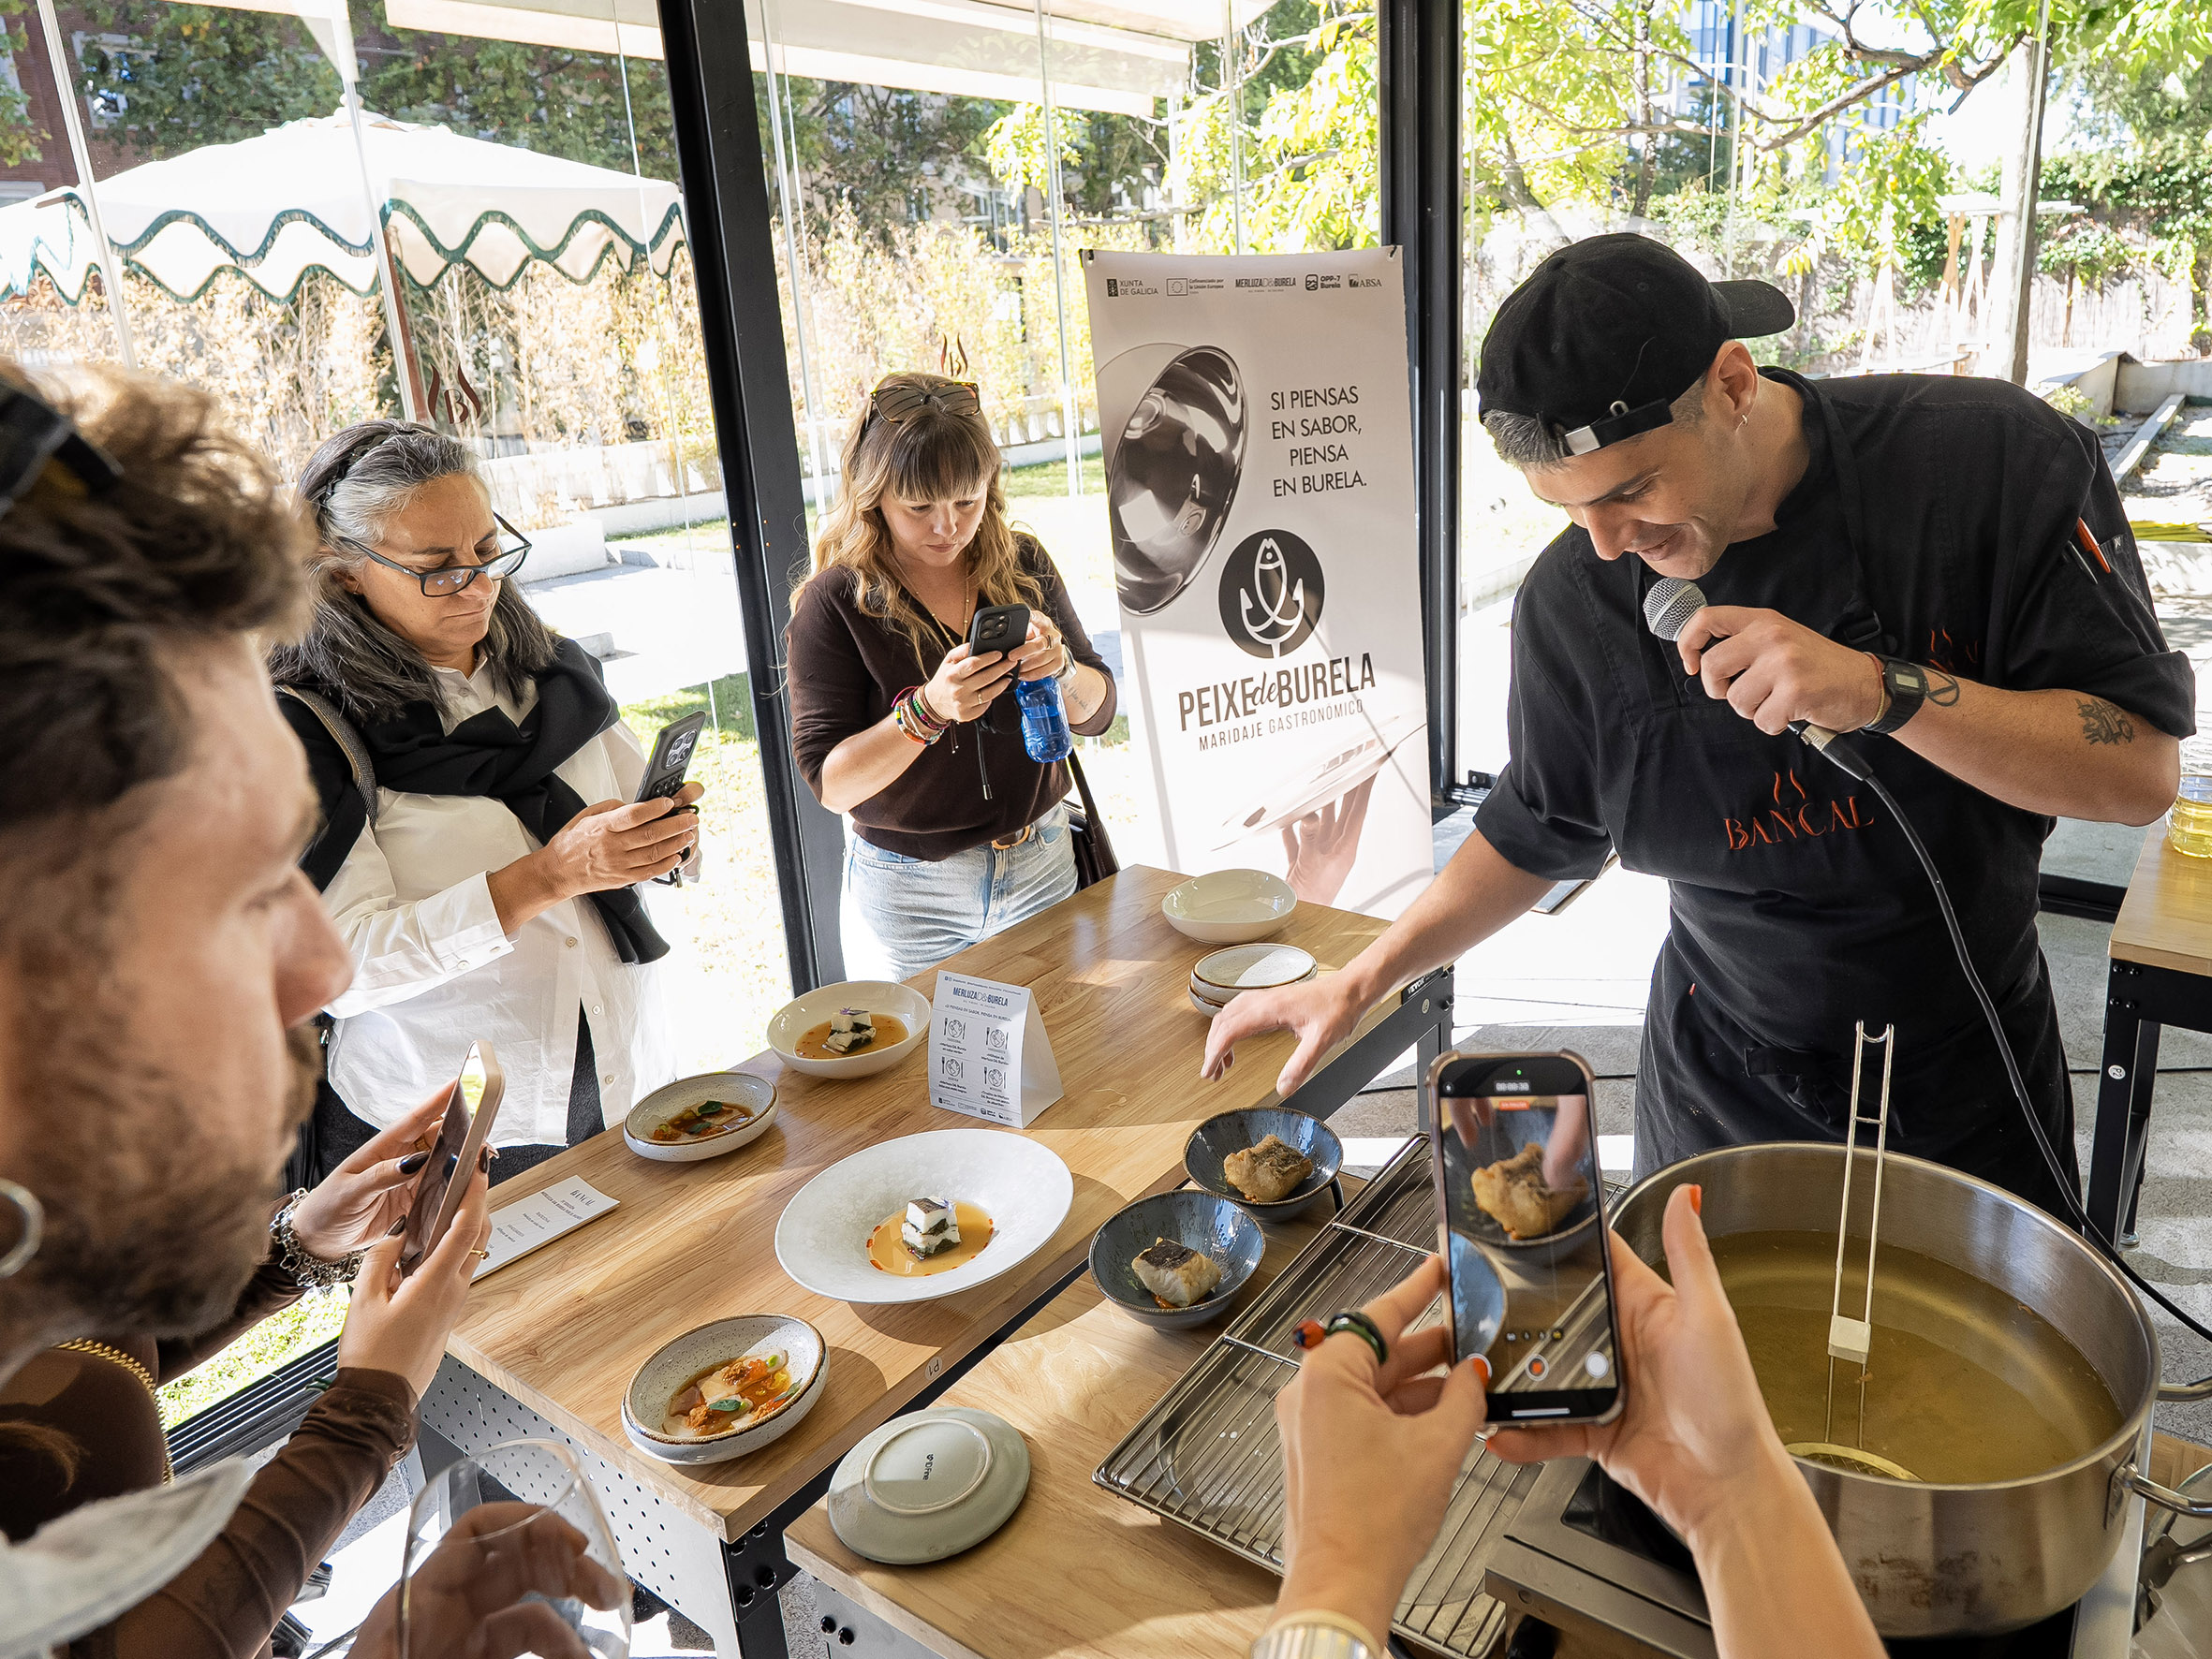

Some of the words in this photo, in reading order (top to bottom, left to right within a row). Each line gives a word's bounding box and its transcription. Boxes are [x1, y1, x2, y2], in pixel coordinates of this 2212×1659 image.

[1130, 287, 1159, 296] GALICIA
[1274, 277, 1296, 286] BURELA
[1359, 279, 1382, 288] ABSA
[1270, 391, 1285, 411] SI
[1290, 385, 1360, 409] PIENSAS
[1272, 419, 1296, 440] EN
[1300, 414, 1363, 438] SABOR,
[1290, 444, 1349, 467] PIENSA
[1273, 478, 1297, 498] EN
[1303, 470, 1368, 495] BURELA.
[1178, 676, 1257, 732] PEIXE
[1276, 652, 1377, 709] BURELA
[1199, 721, 1263, 752] MARIDAJE
[1268, 698, 1364, 735] GASTRONÓMICO
[1723, 796, 1875, 851] BANCAL
[952, 987, 978, 1000] MERLUZA
[987, 994, 1009, 1006] BURELA
